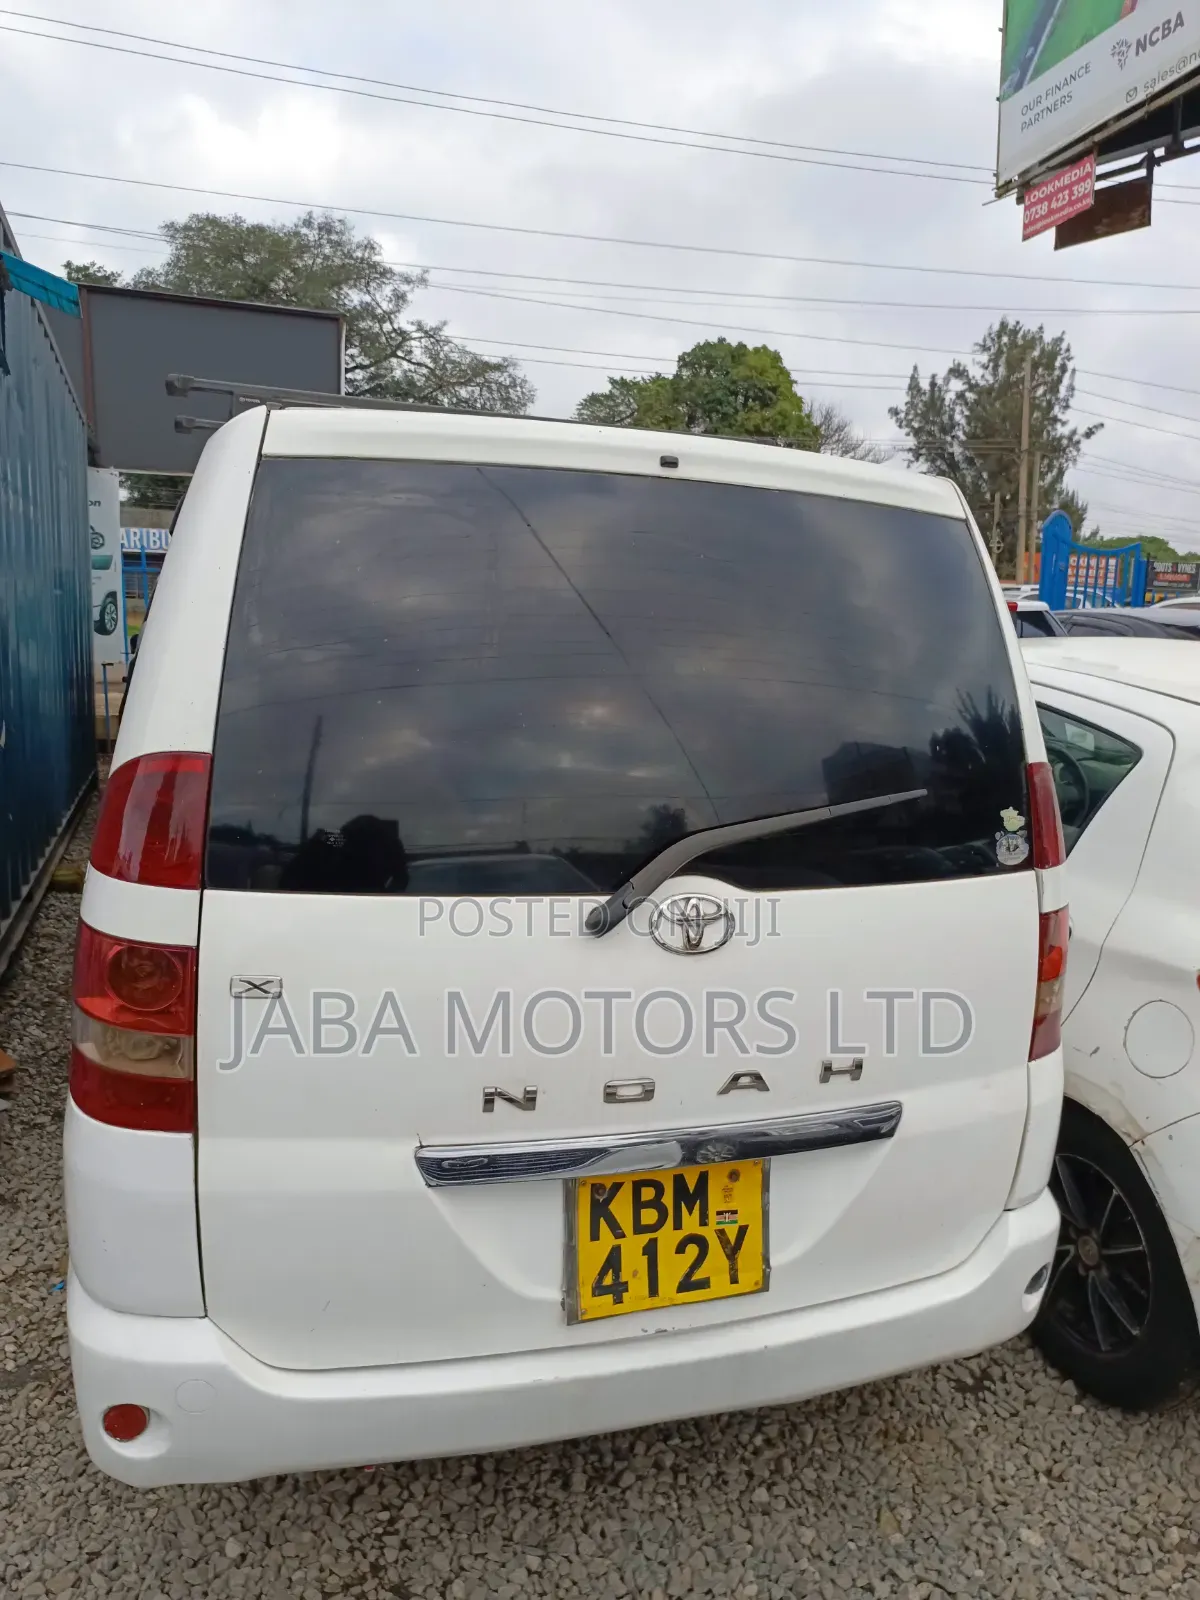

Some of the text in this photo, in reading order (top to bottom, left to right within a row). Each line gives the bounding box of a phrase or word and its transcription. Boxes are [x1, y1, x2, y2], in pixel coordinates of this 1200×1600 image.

[1135, 11, 1185, 57] NCBA
[1020, 91, 1073, 133] PARTNERS
[1021, 61, 1092, 117] OUR FINANCE
[1024, 179, 1092, 224] 0738 423 399
[1025, 163, 1092, 206] LOOKMEDIA
[482, 1057, 863, 1113] NOAH
[589, 1170, 710, 1242] KBM
[591, 1224, 750, 1306] 412Y
